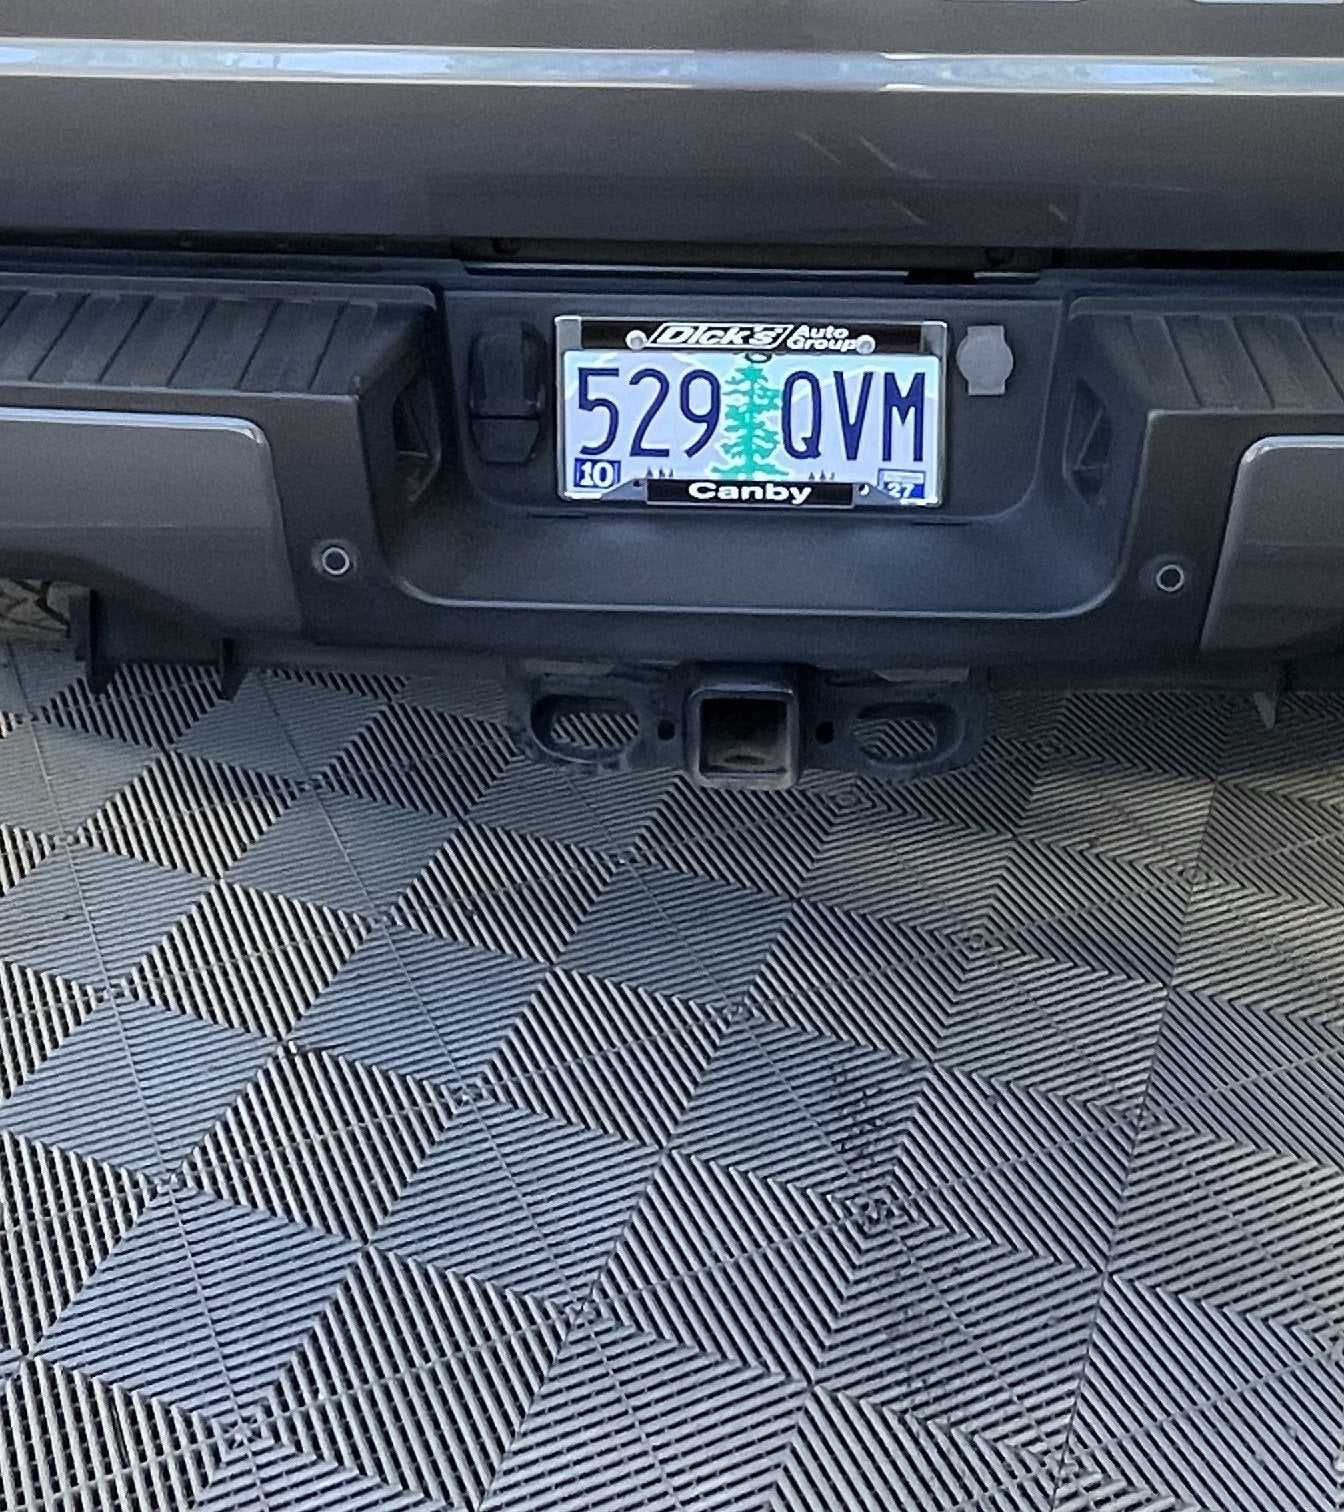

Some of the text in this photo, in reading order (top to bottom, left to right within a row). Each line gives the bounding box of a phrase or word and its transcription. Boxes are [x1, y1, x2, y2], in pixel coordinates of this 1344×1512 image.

[793, 324, 849, 339] Auto
[786, 337, 857, 353] Group
[578, 366, 924, 462] 529 QVM
[580, 461, 614, 488] 10
[688, 481, 812, 506] Canby
